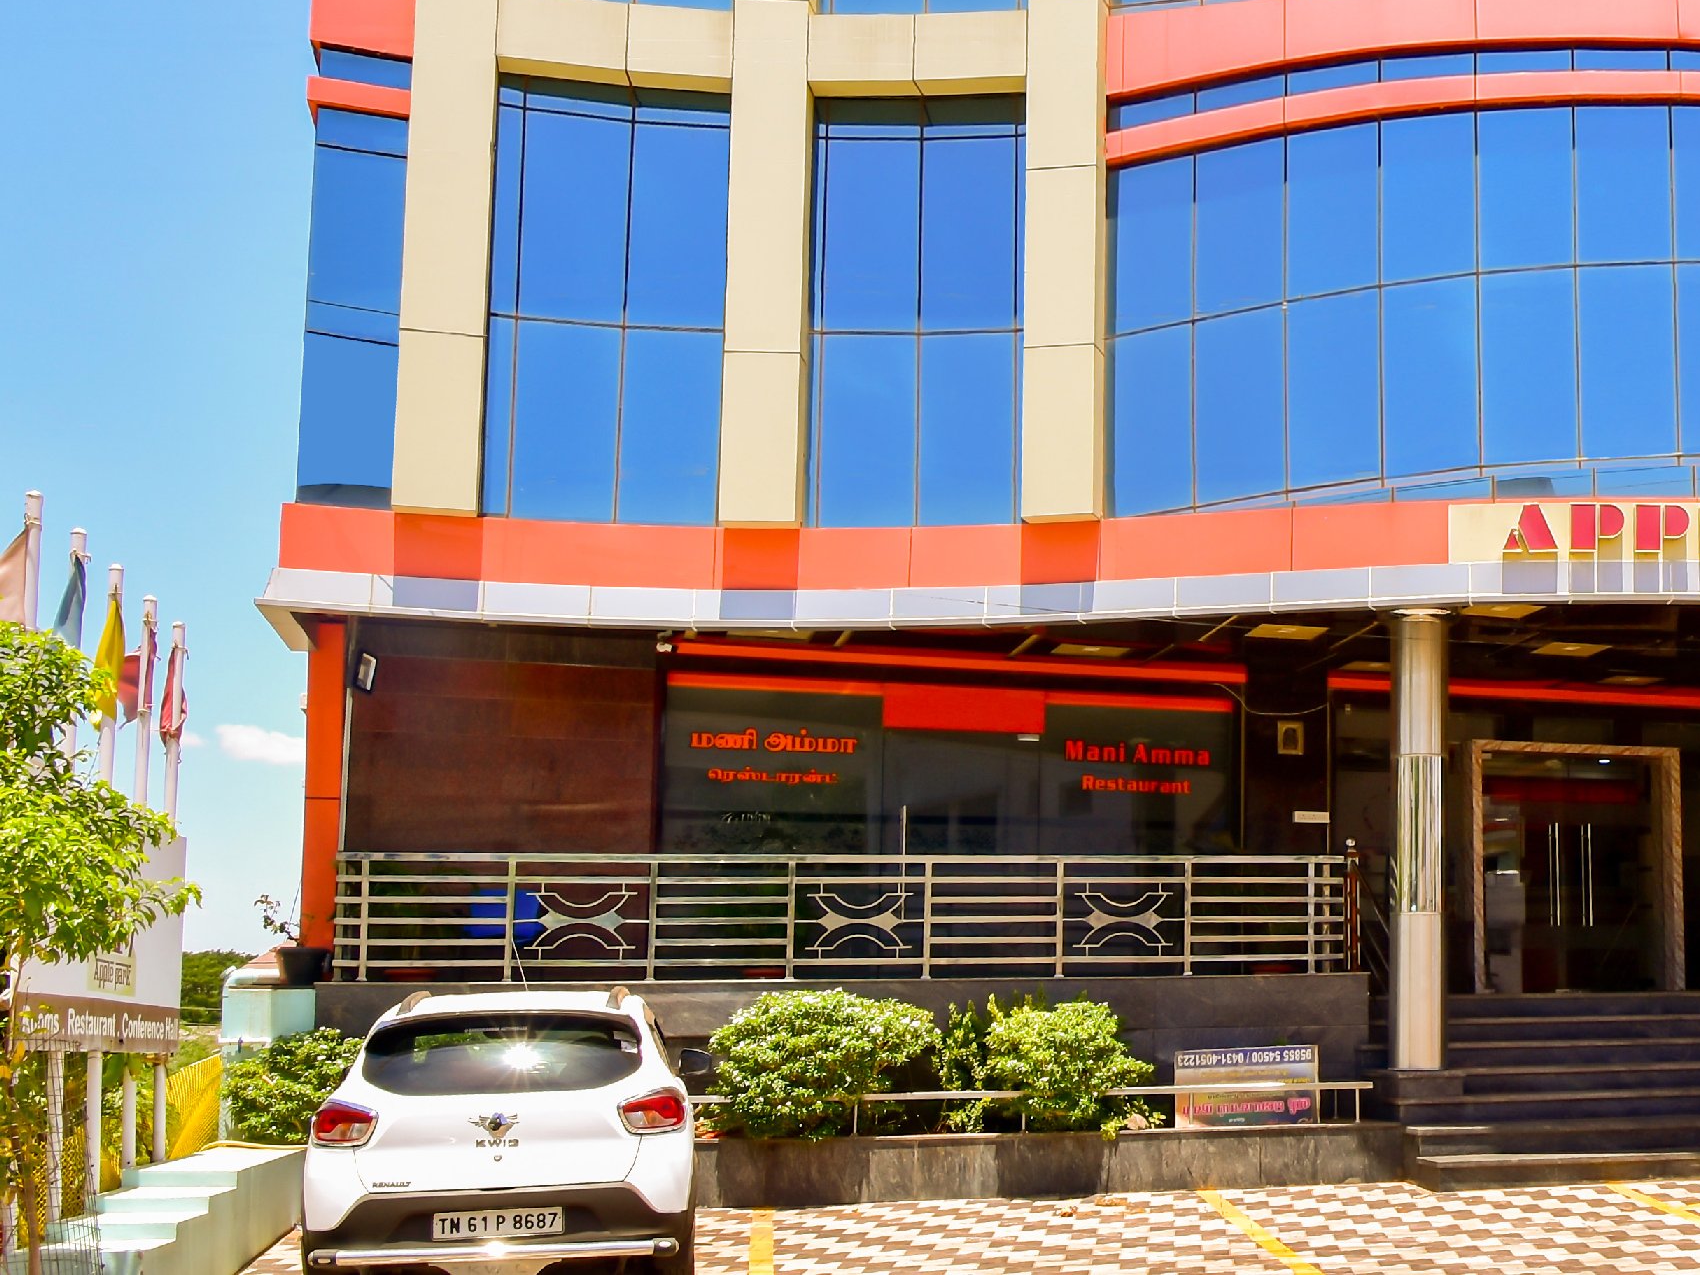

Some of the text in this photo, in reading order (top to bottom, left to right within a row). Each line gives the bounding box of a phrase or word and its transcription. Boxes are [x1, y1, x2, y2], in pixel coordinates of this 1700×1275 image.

[690, 728, 858, 754] மணி அம்மா
[1065, 739, 1211, 766] Mani Amma
[1081, 775, 1192, 794] Restaurant
[94, 958, 114, 989] Apple
[68, 1007, 116, 1037] Restaurant
[122, 1012, 165, 1040] Conference
[439, 1212, 558, 1234] TN 61 P 8687
